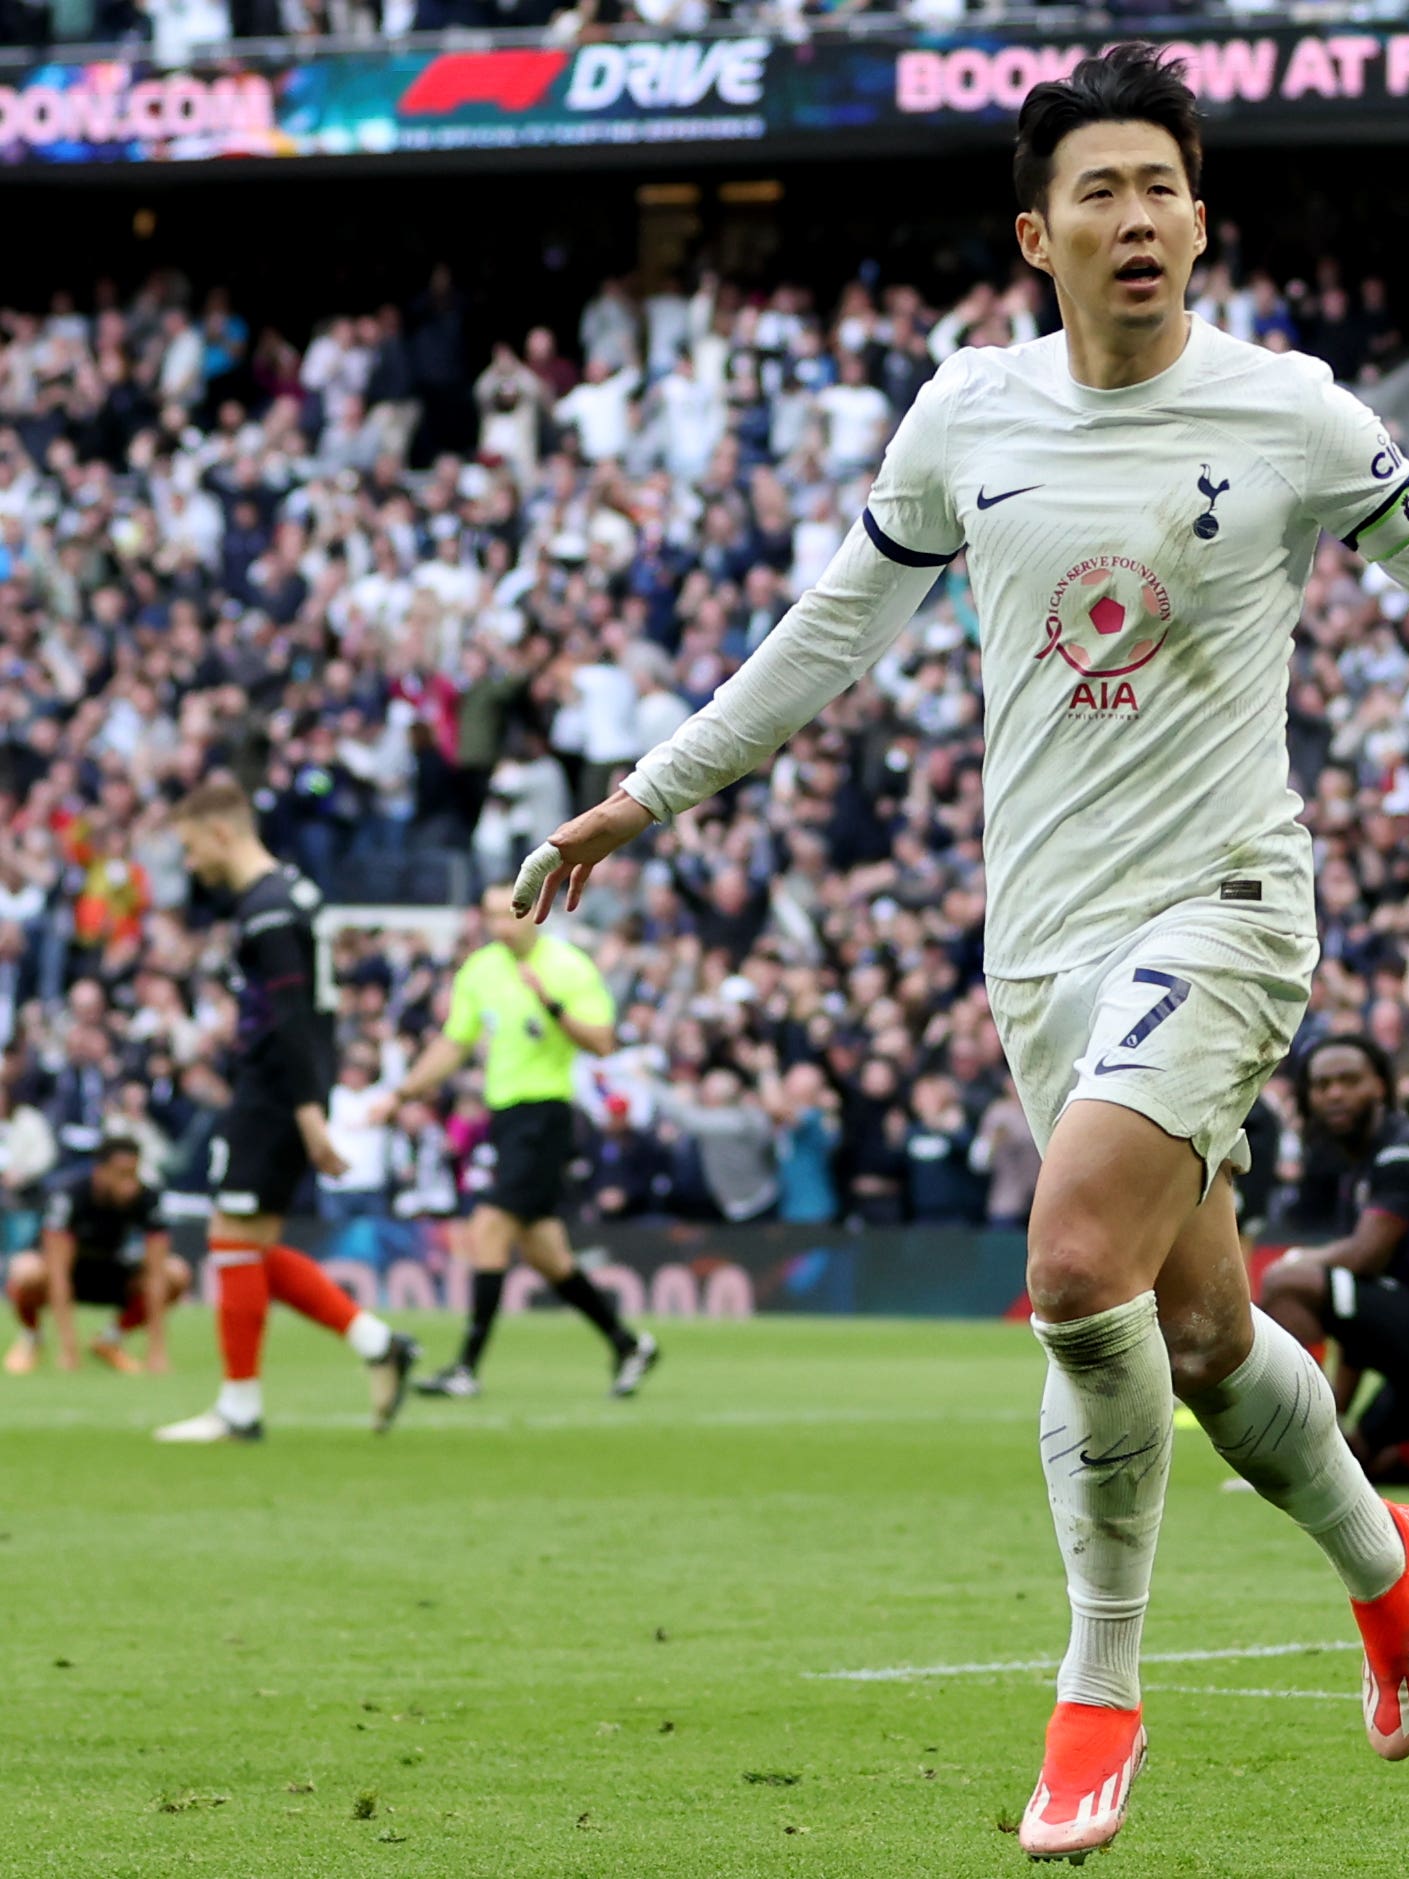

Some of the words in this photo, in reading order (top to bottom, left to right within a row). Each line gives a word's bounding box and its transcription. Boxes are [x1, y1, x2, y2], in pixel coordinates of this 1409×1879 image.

[565, 38, 771, 111] DRIVE
[1282, 36, 1380, 98] AT
[1066, 555, 1110, 582] SERVE
[1111, 556, 1172, 622] FOUNDATION
[1069, 682, 1139, 711] AIA
[1118, 968, 1192, 1049] 7
